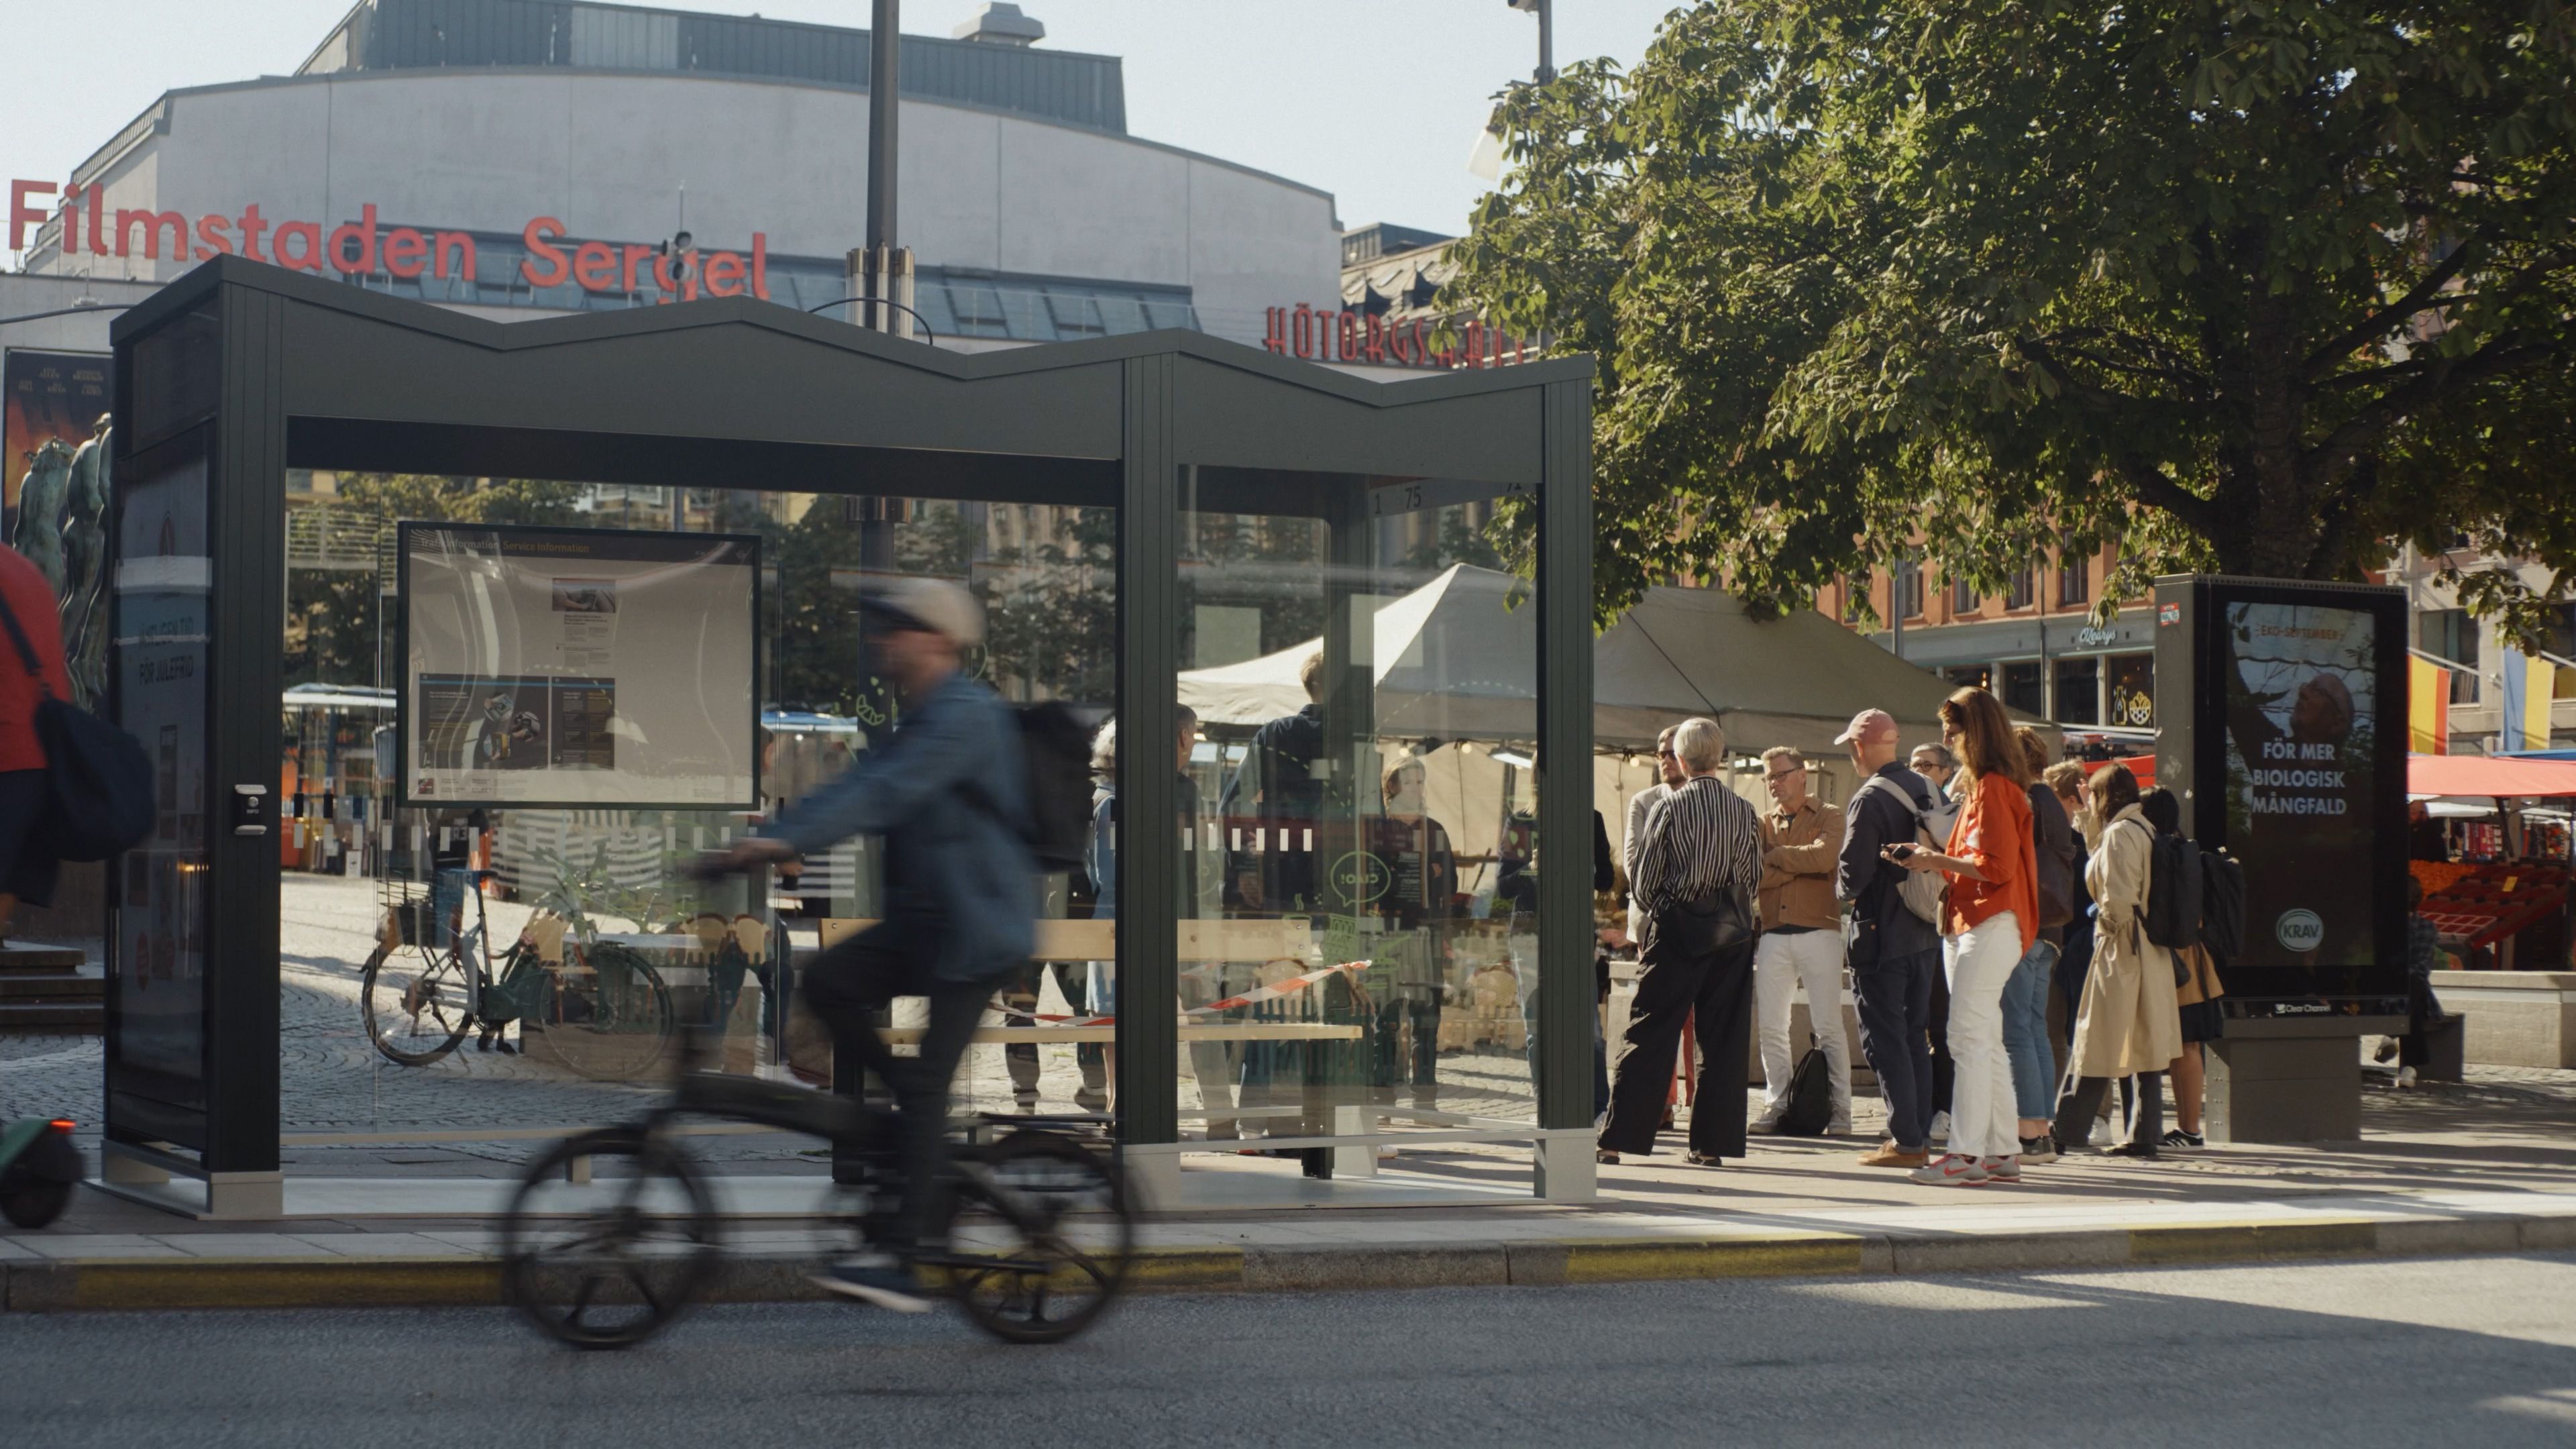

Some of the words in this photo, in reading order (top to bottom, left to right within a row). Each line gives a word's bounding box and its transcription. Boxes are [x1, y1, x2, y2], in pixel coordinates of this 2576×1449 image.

[9, 179, 476, 282] Filmstaden
[519, 215, 771, 304] Sergel
[1405, 486, 1421, 510] 75
[502, 541, 536, 551] Service
[537, 542, 590, 554] Information
[2263, 737, 2297, 759] FÖR
[2300, 743, 2336, 761] MER
[2253, 769, 2346, 788] BIOLOGISK
[2252, 791, 2347, 815] MÅNGFALD
[2283, 924, 2320, 939] KRAV
[2286, 1004, 2304, 1012] Clear
[2304, 1004, 2331, 1012] Channel
